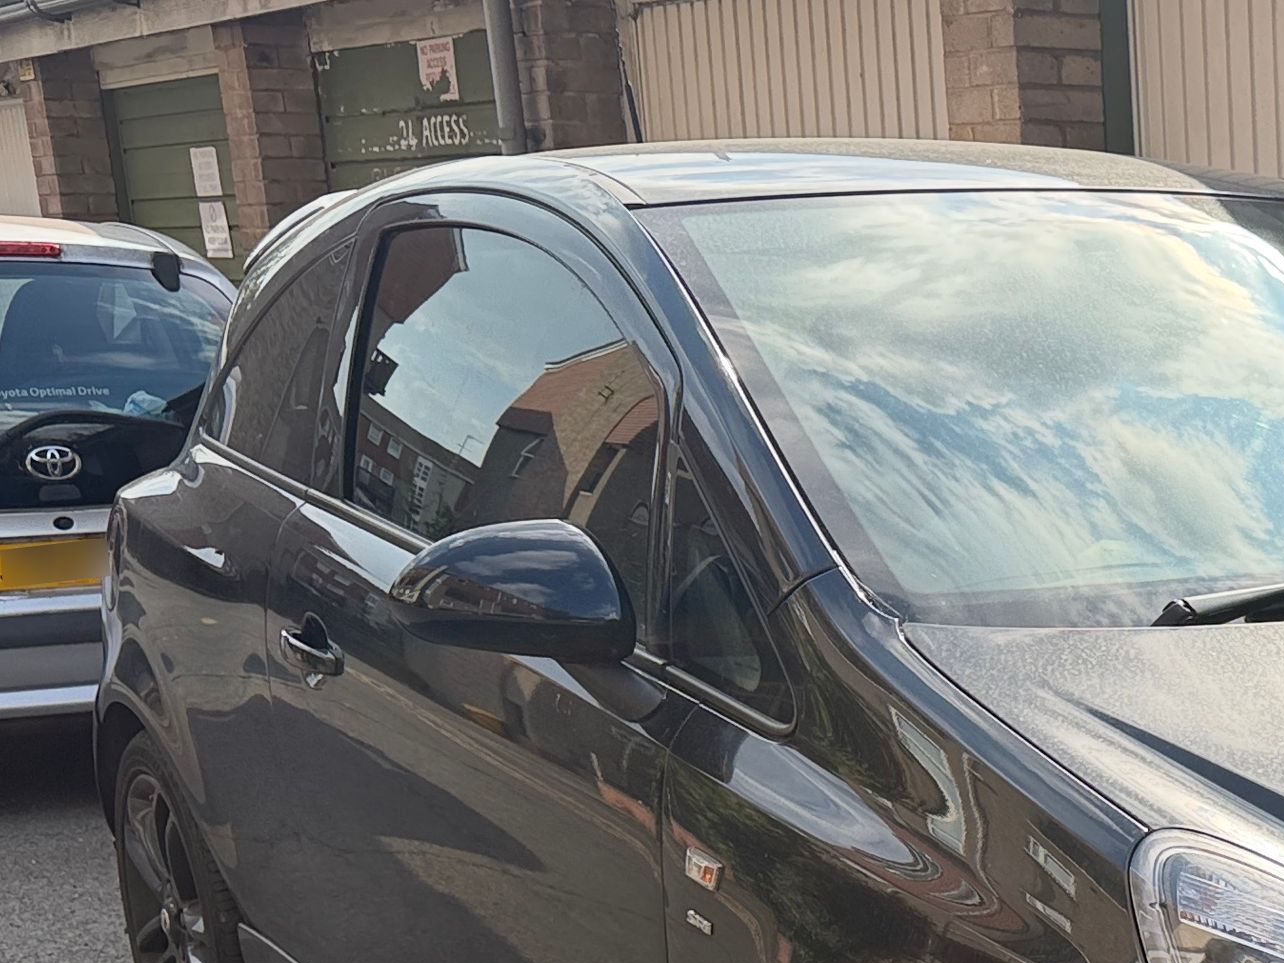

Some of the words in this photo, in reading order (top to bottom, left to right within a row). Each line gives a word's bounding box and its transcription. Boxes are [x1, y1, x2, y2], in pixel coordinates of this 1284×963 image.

[422, 114, 470, 147] ACCESS
[0, 388, 28, 400] yota
[29, 387, 76, 398] Optimal
[77, 386, 110, 396] Drive
